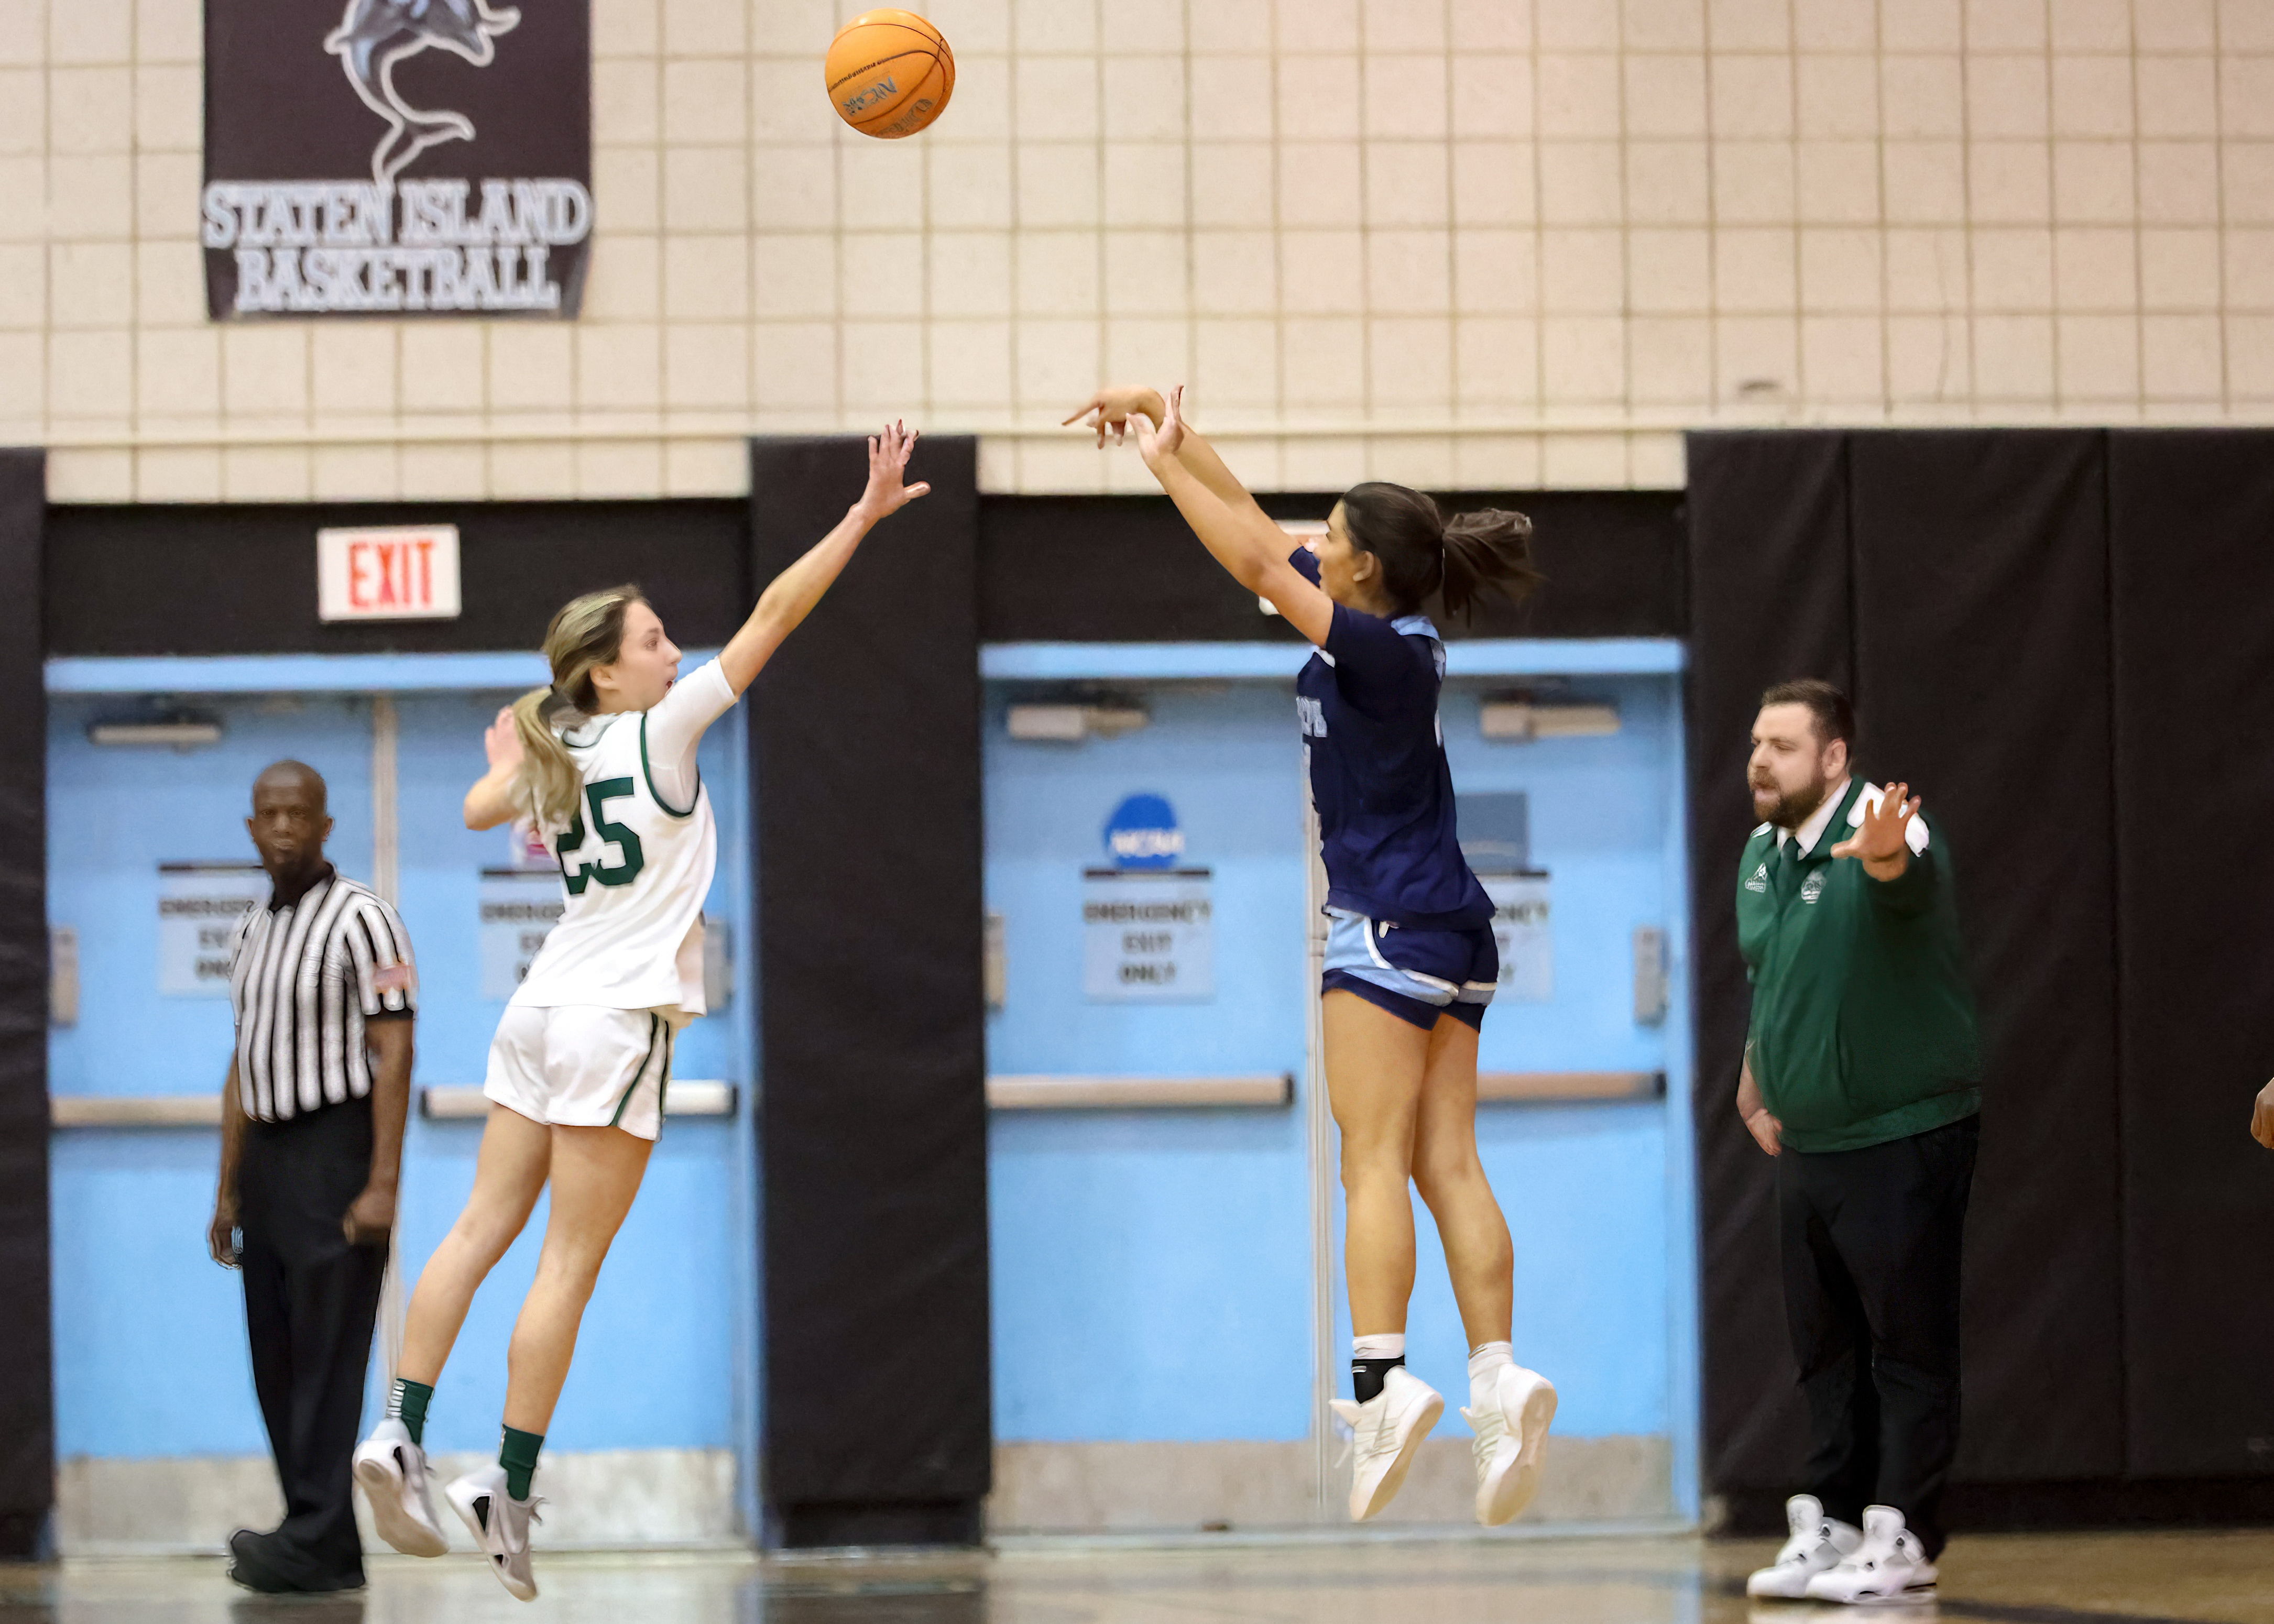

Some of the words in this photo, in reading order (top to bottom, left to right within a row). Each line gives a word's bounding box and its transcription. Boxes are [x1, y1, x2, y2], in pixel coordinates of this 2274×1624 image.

[202, 180, 394, 248] STATEN
[398, 179, 594, 246] ISLAND
[235, 246, 561, 312] BASKETBALL
[348, 540, 434, 608] EXIT
[557, 776, 644, 896] 25
[1083, 901, 1211, 924] EMERGENCY
[1122, 931, 1172, 954] EXIT
[1120, 963, 1176, 984] ONLY
